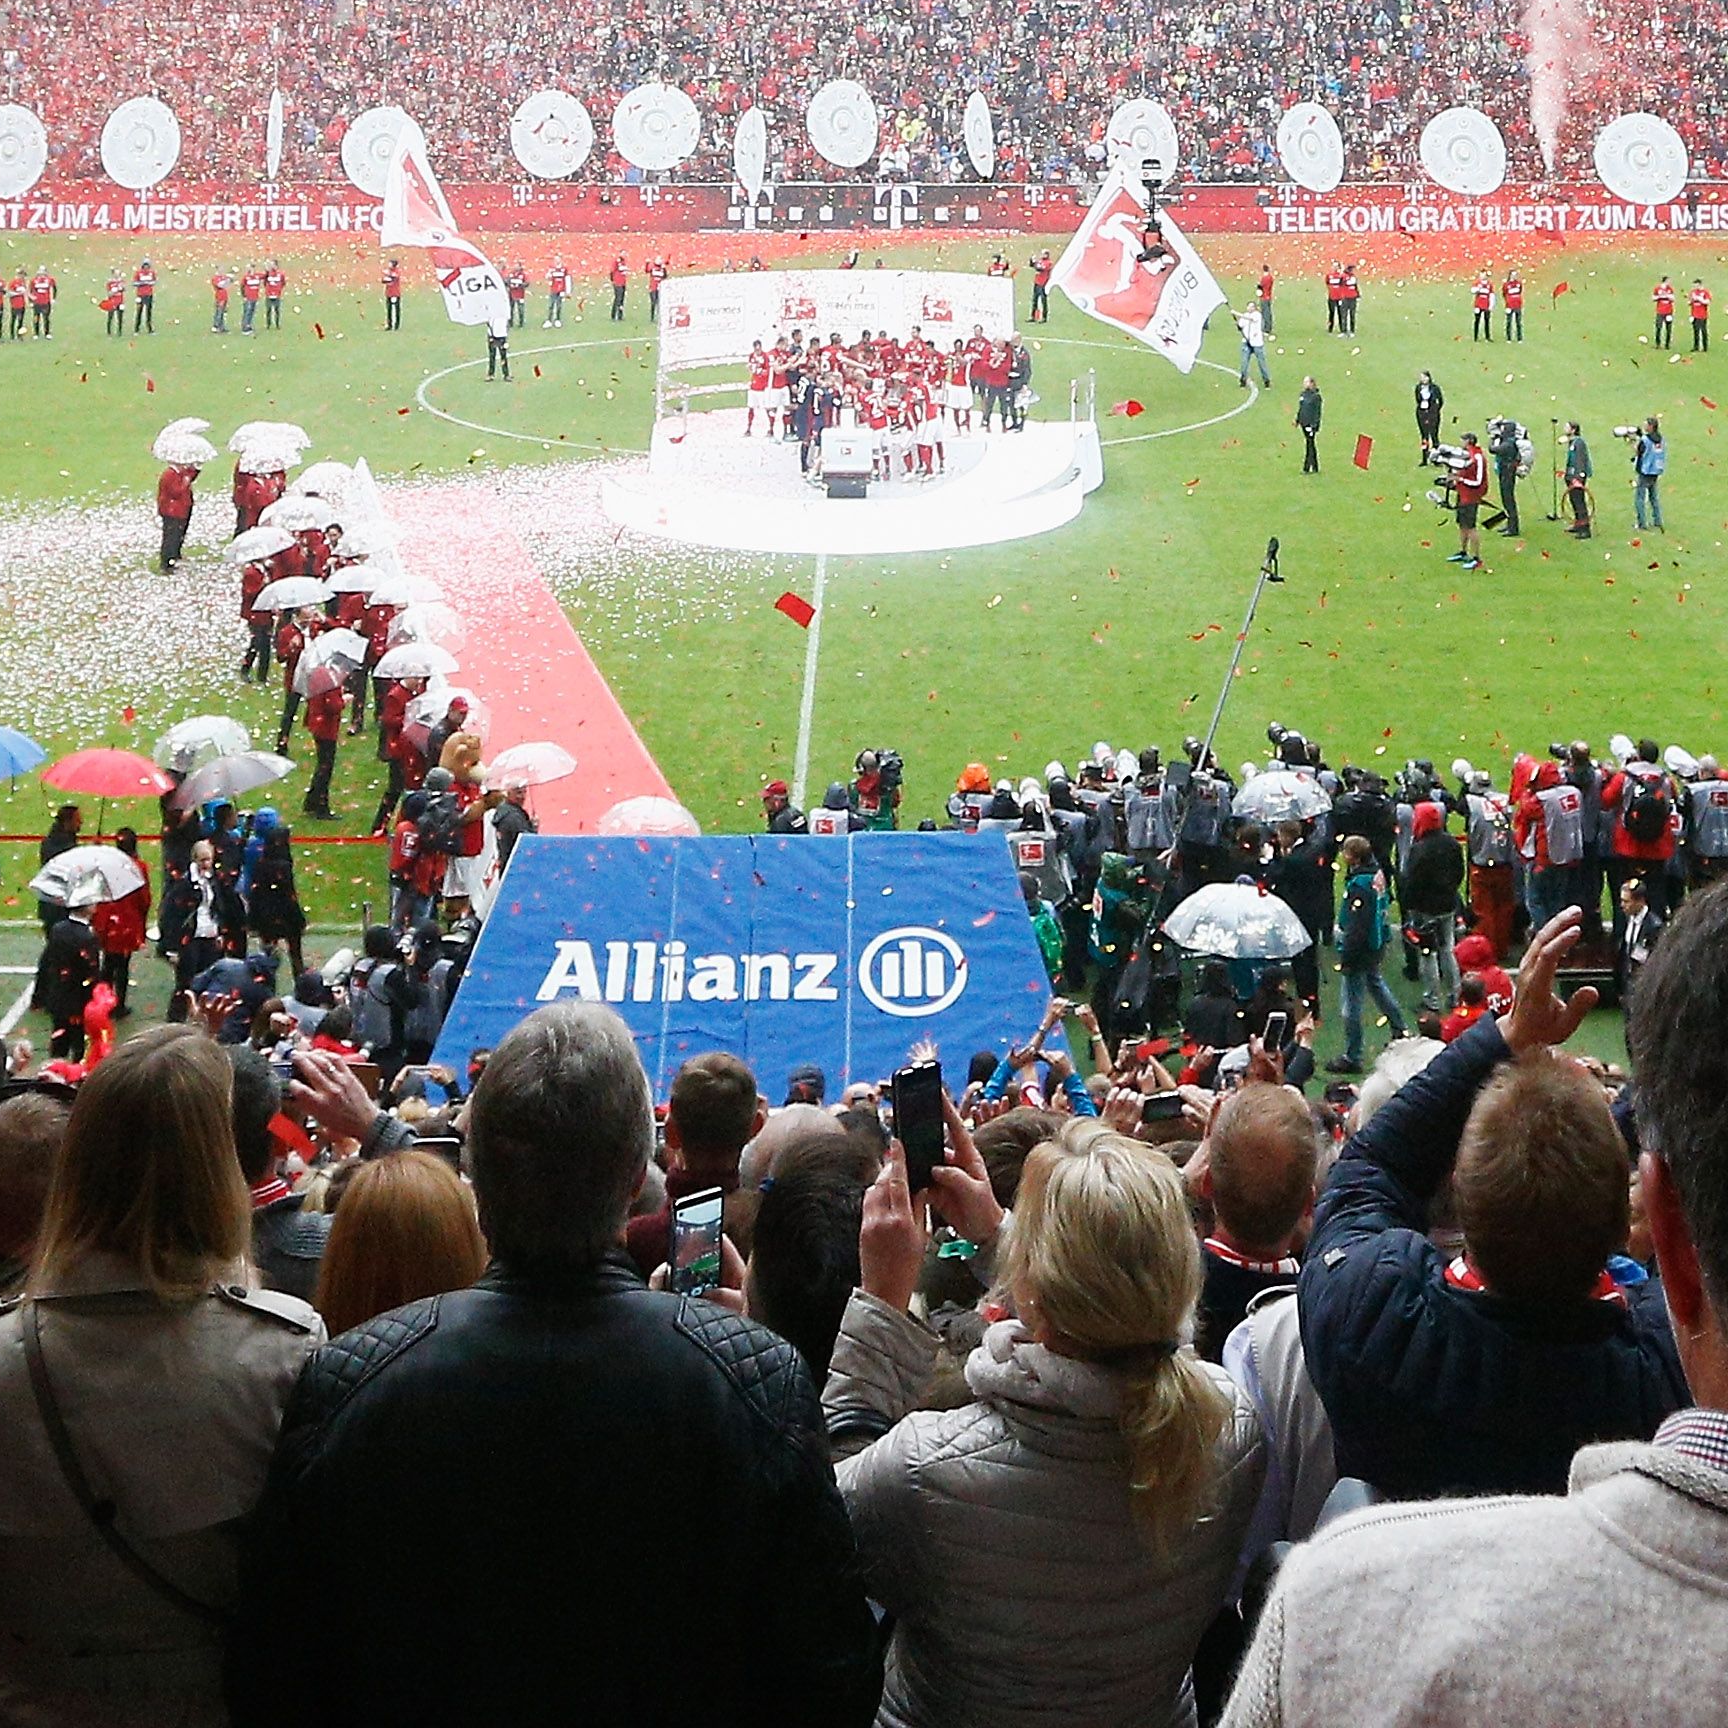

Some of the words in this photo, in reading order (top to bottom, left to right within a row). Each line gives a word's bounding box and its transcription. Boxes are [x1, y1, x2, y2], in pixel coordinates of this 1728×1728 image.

[27, 203, 91, 230] ZUM
[93, 203, 118, 230] 4.
[124, 203, 317, 231] MEISTERTITEL
[322, 203, 351, 231] IN
[1263, 205, 1392, 232] TELEKOM
[1399, 205, 1571, 232] GRATULIERT
[1575, 205, 1641, 231] ZUM
[1640, 204, 1666, 230] 4.
[535, 939, 839, 1003] Allianz
